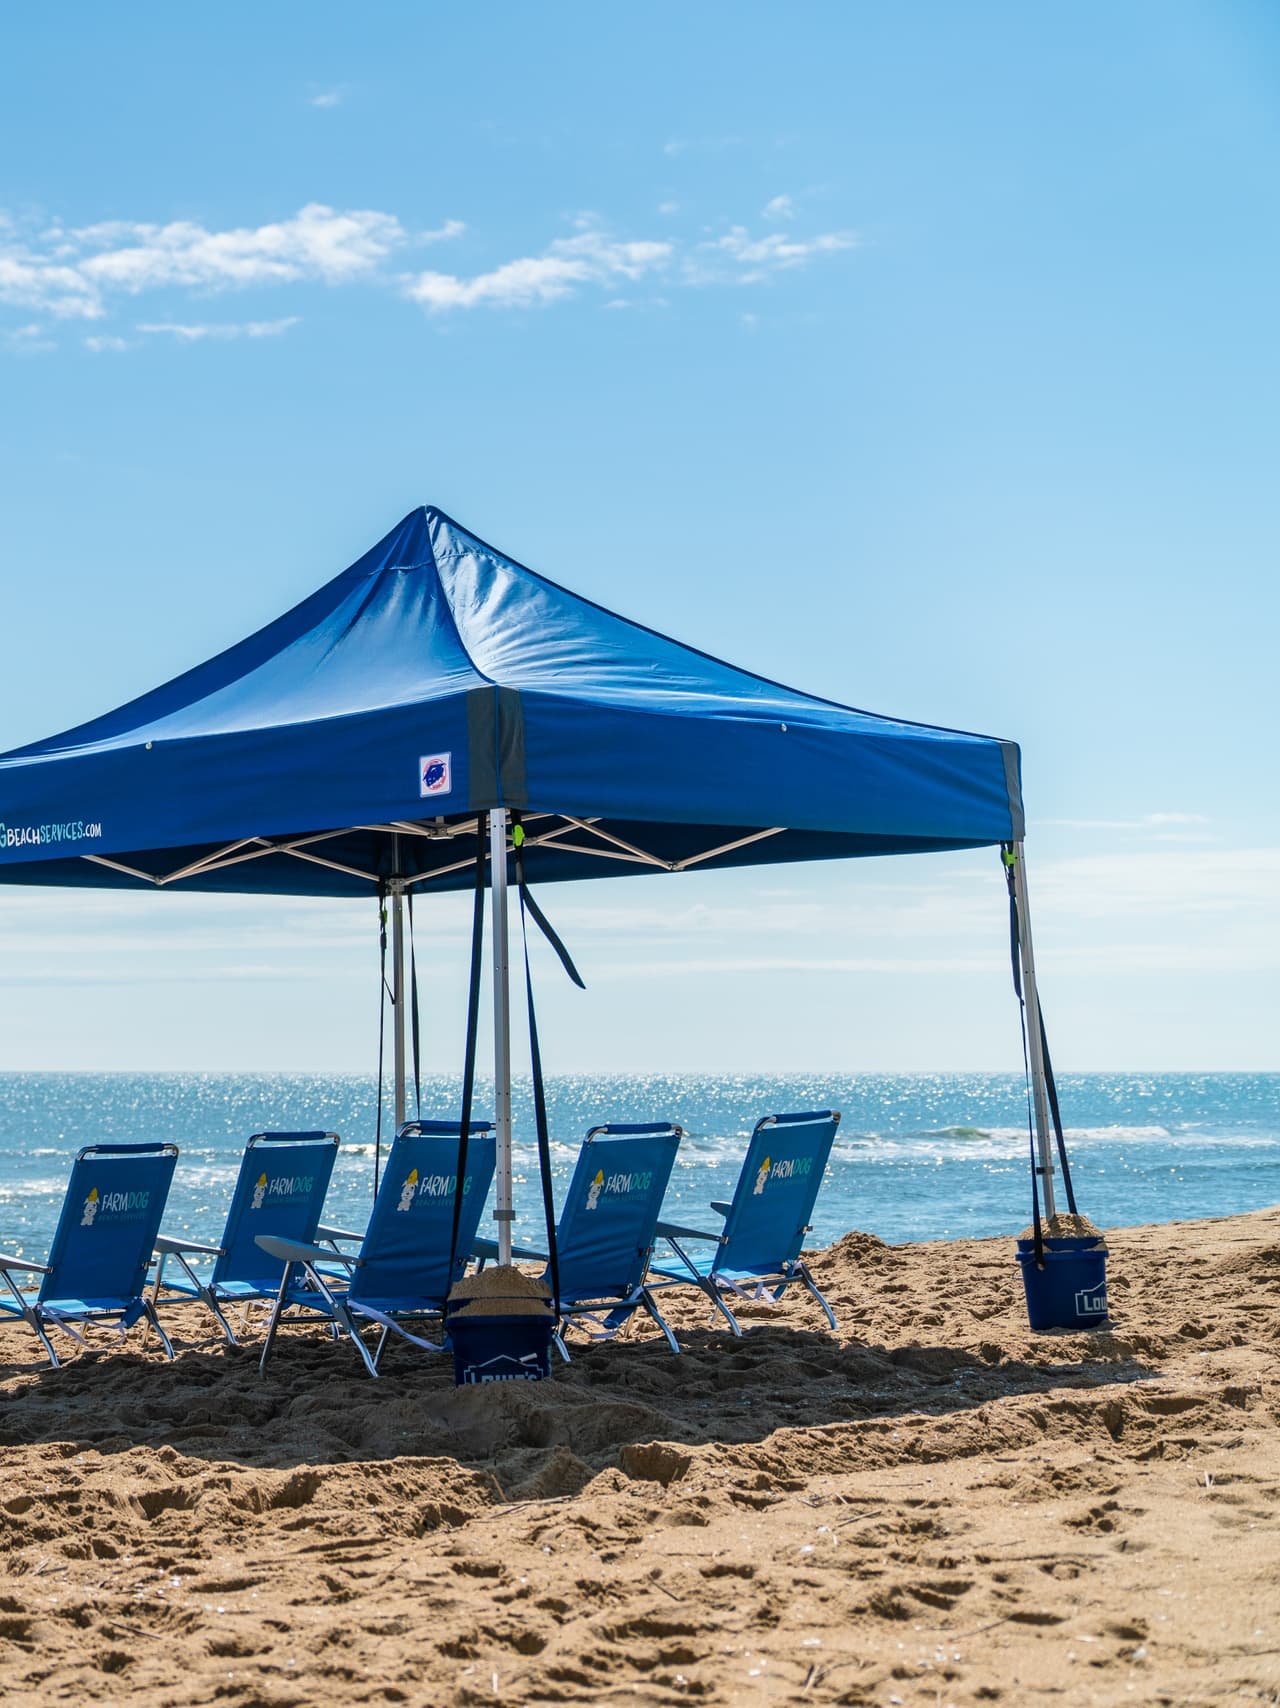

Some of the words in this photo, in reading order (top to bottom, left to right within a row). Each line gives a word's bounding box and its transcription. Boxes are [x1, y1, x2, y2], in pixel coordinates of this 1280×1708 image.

[771, 1157, 813, 1179] FARMDOG
[268, 1176, 314, 1196] FARMDOG
[419, 1174, 473, 1197] FARMDG
[604, 1171, 652, 1194] FARMDOG
[101, 1191, 150, 1212] FARMDOG
